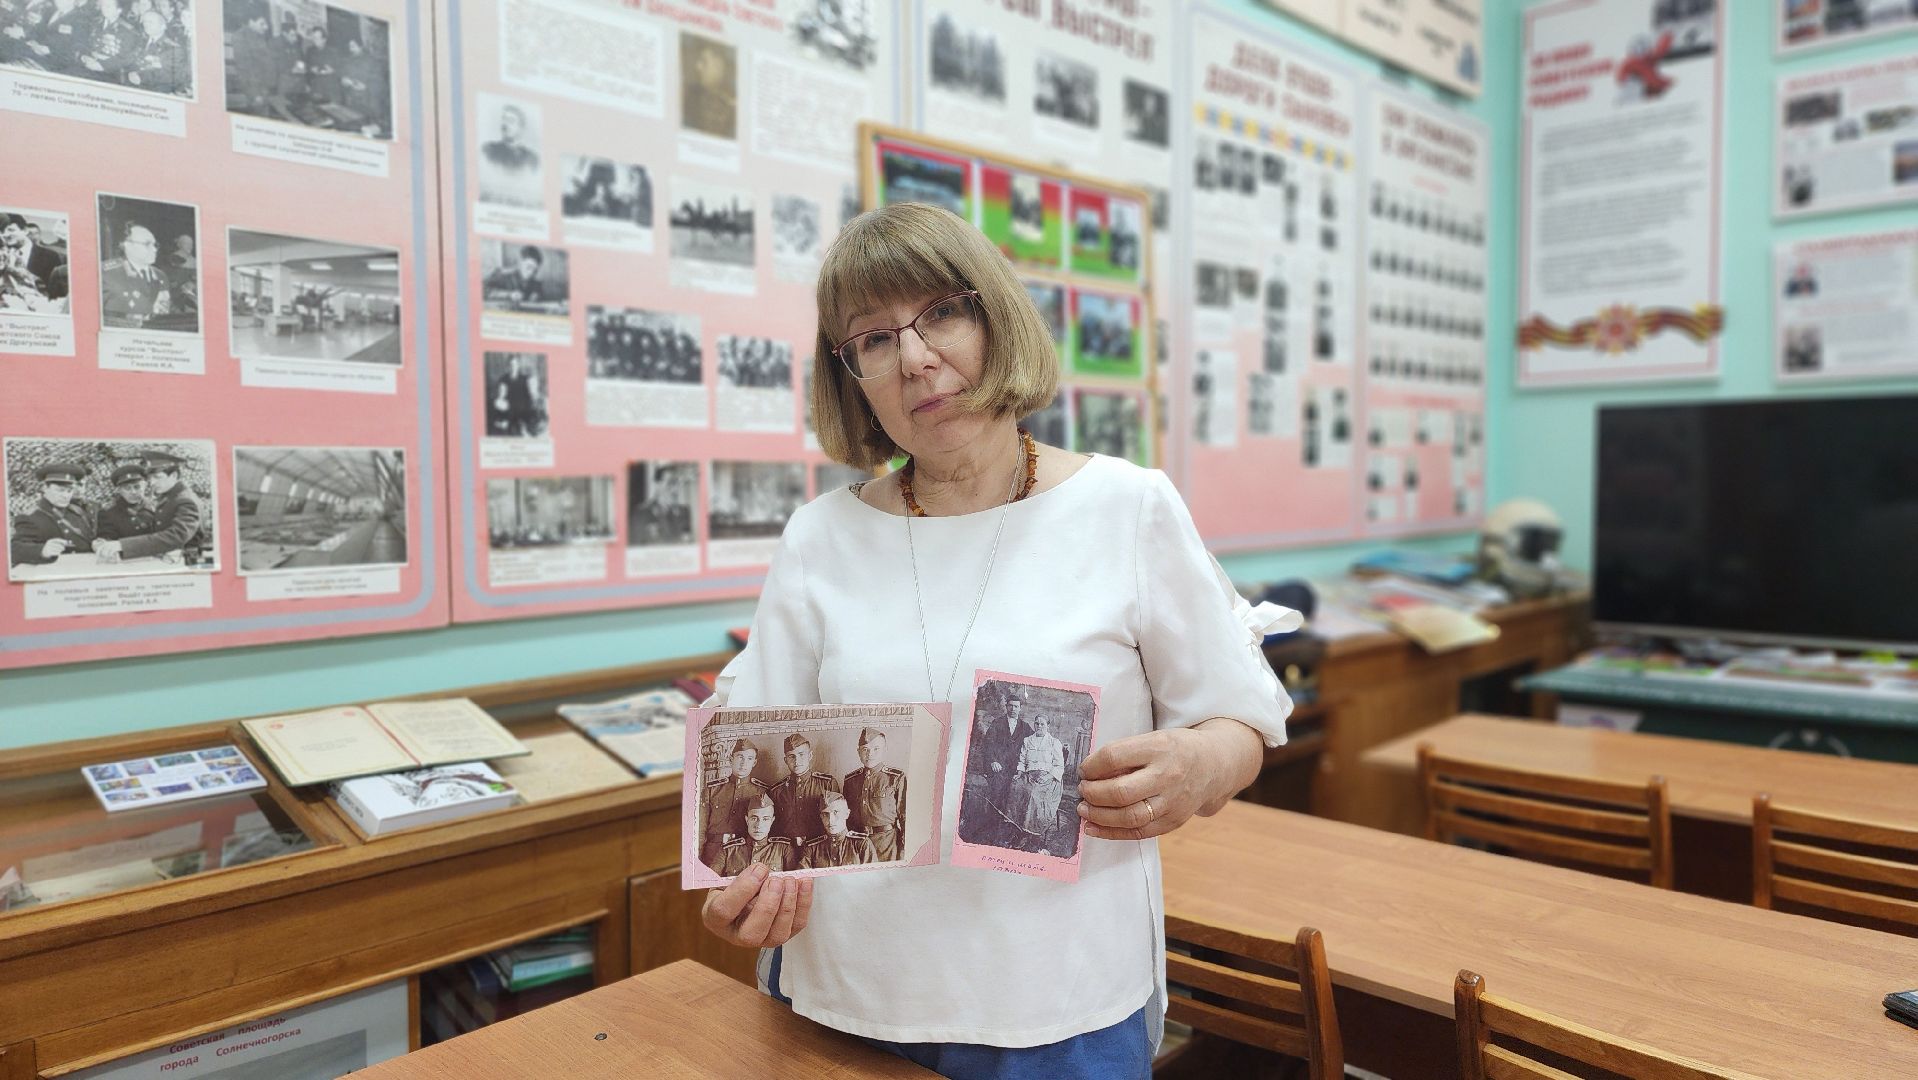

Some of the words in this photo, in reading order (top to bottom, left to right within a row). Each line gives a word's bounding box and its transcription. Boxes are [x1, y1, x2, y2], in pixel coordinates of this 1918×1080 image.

[160, 1055, 199, 1072] города
[216, 1027, 302, 1057] Солнечногорска
[169, 1032, 226, 1054] Советская
[238, 1017, 286, 1036] площадь
